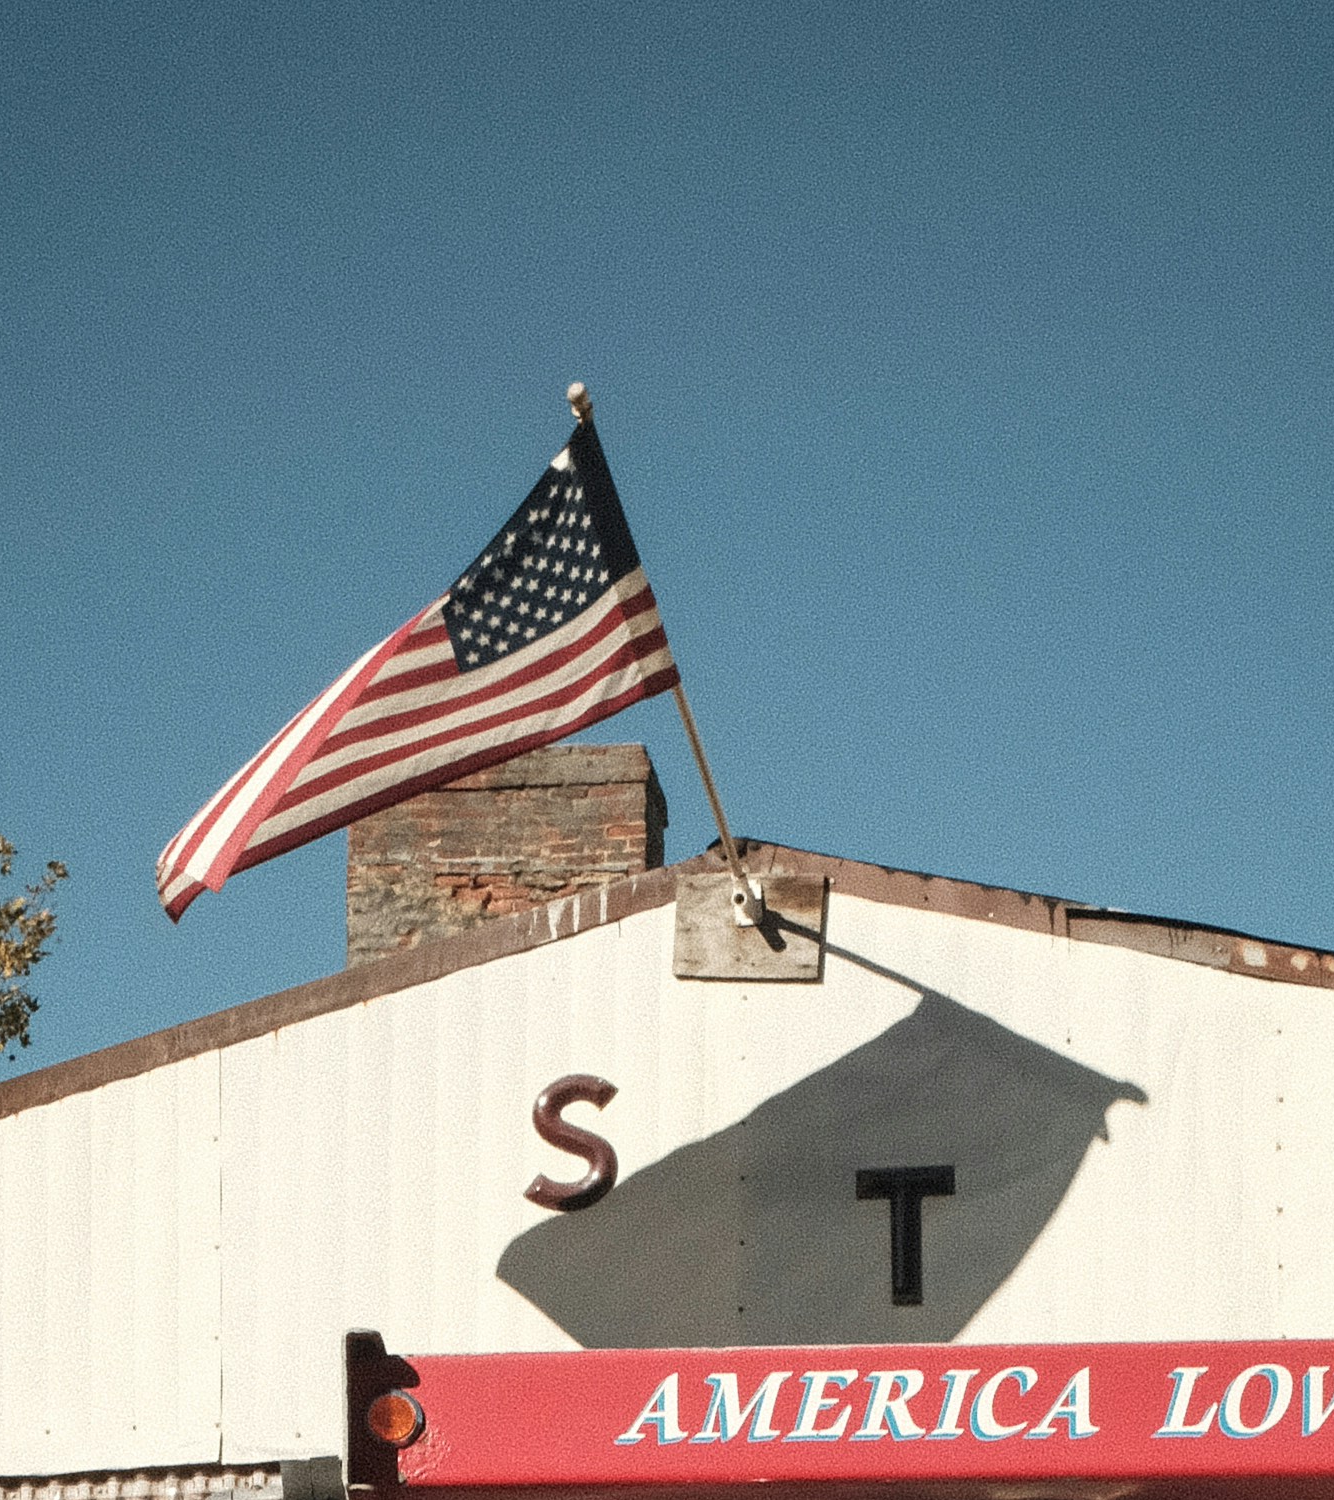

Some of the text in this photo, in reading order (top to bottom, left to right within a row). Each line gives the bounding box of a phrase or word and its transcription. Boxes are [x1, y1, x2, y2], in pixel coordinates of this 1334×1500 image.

[522, 1073, 619, 1212] S
[855, 1164, 956, 1306] T
[613, 1365, 1101, 1446] AMERICA
